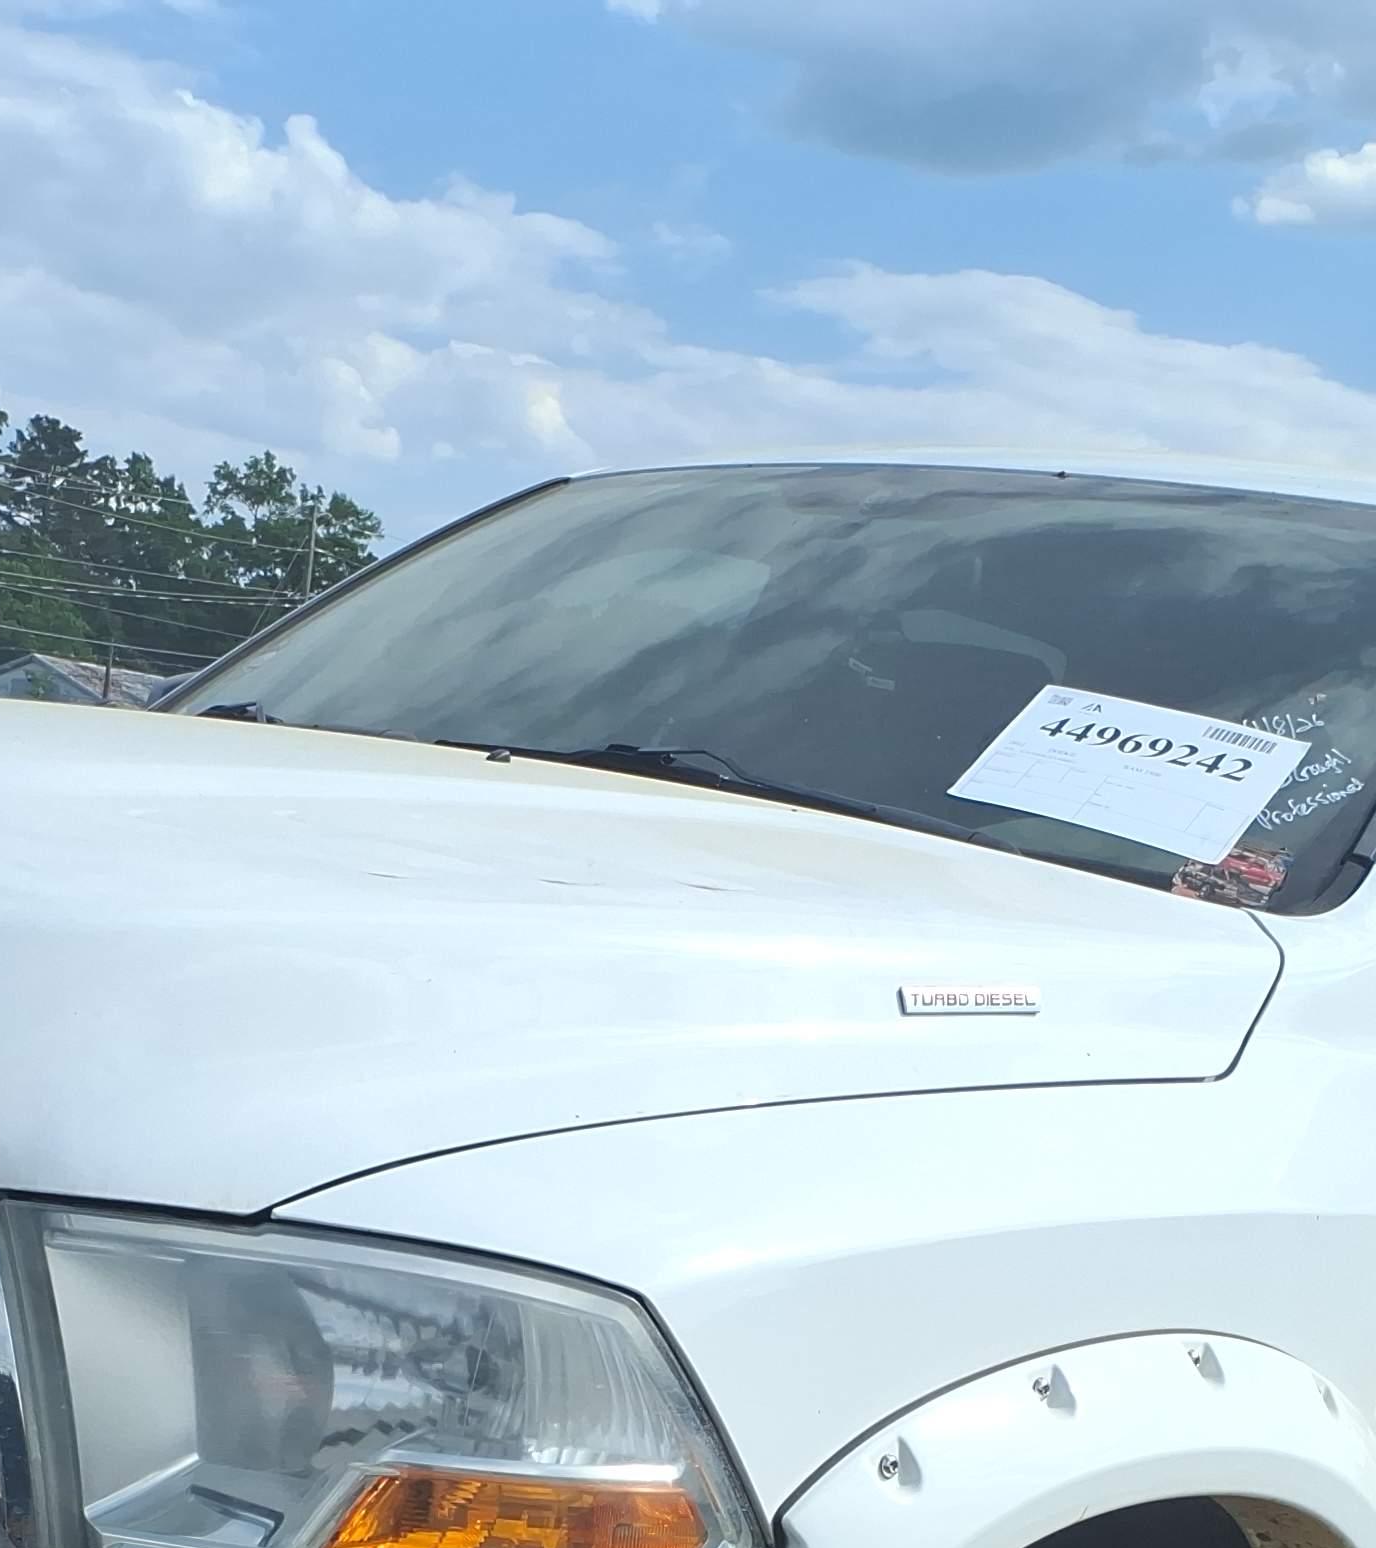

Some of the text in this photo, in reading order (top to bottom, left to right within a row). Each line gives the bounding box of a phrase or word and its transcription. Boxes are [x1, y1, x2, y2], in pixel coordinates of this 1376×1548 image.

[1039, 717, 1254, 783] 44969242
[910, 992, 1037, 1007] TURBO DIESEL
